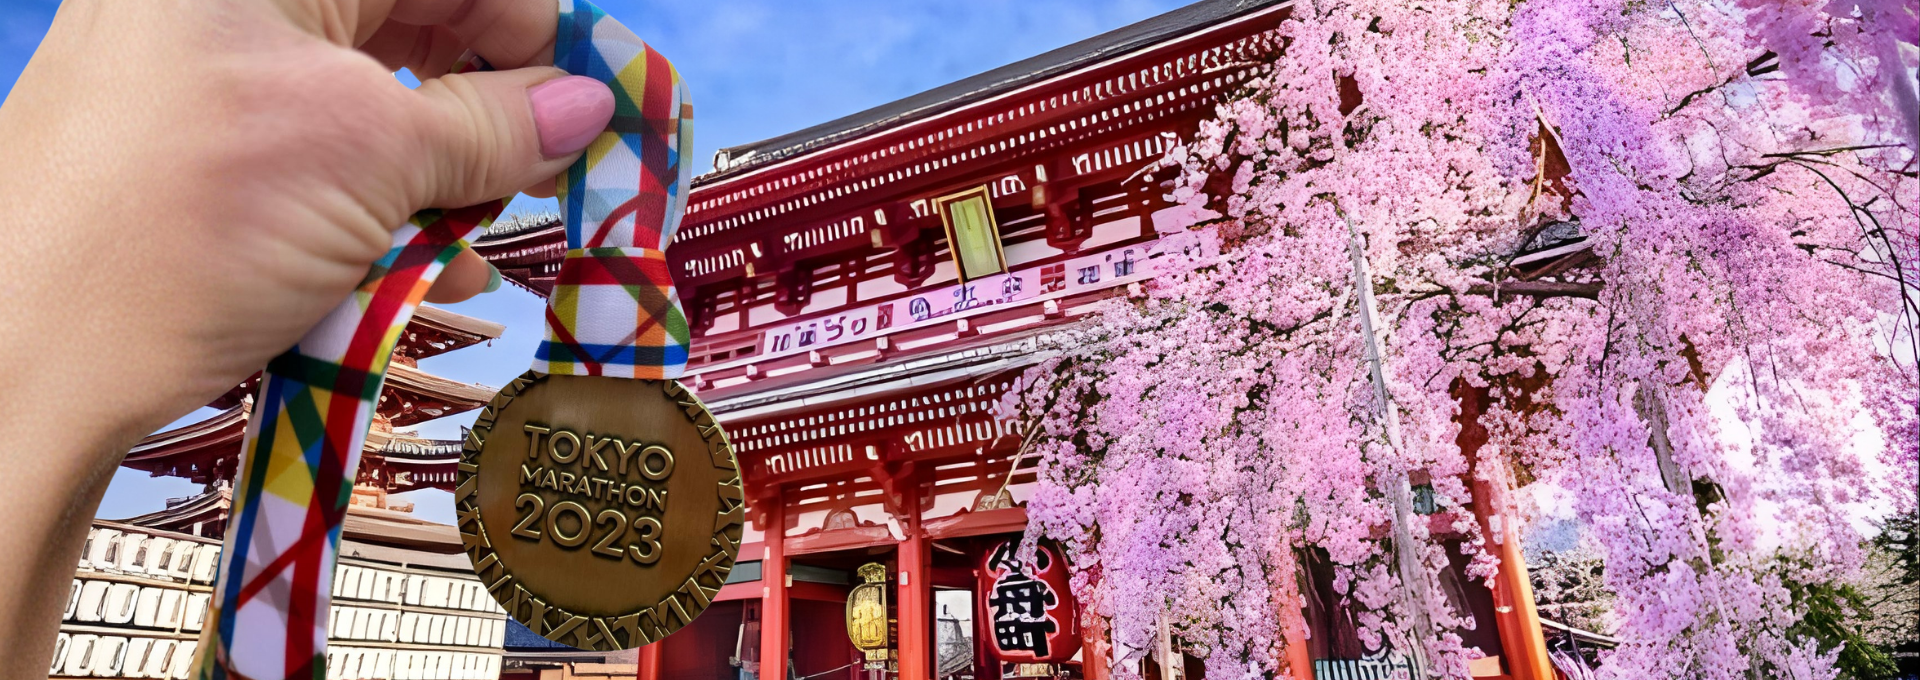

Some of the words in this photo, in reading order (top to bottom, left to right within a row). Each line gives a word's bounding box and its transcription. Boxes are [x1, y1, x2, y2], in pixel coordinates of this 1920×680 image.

[523, 424, 675, 481] TOKYO
[519, 464, 668, 512] MARATHON
[510, 492, 663, 565] 2023
